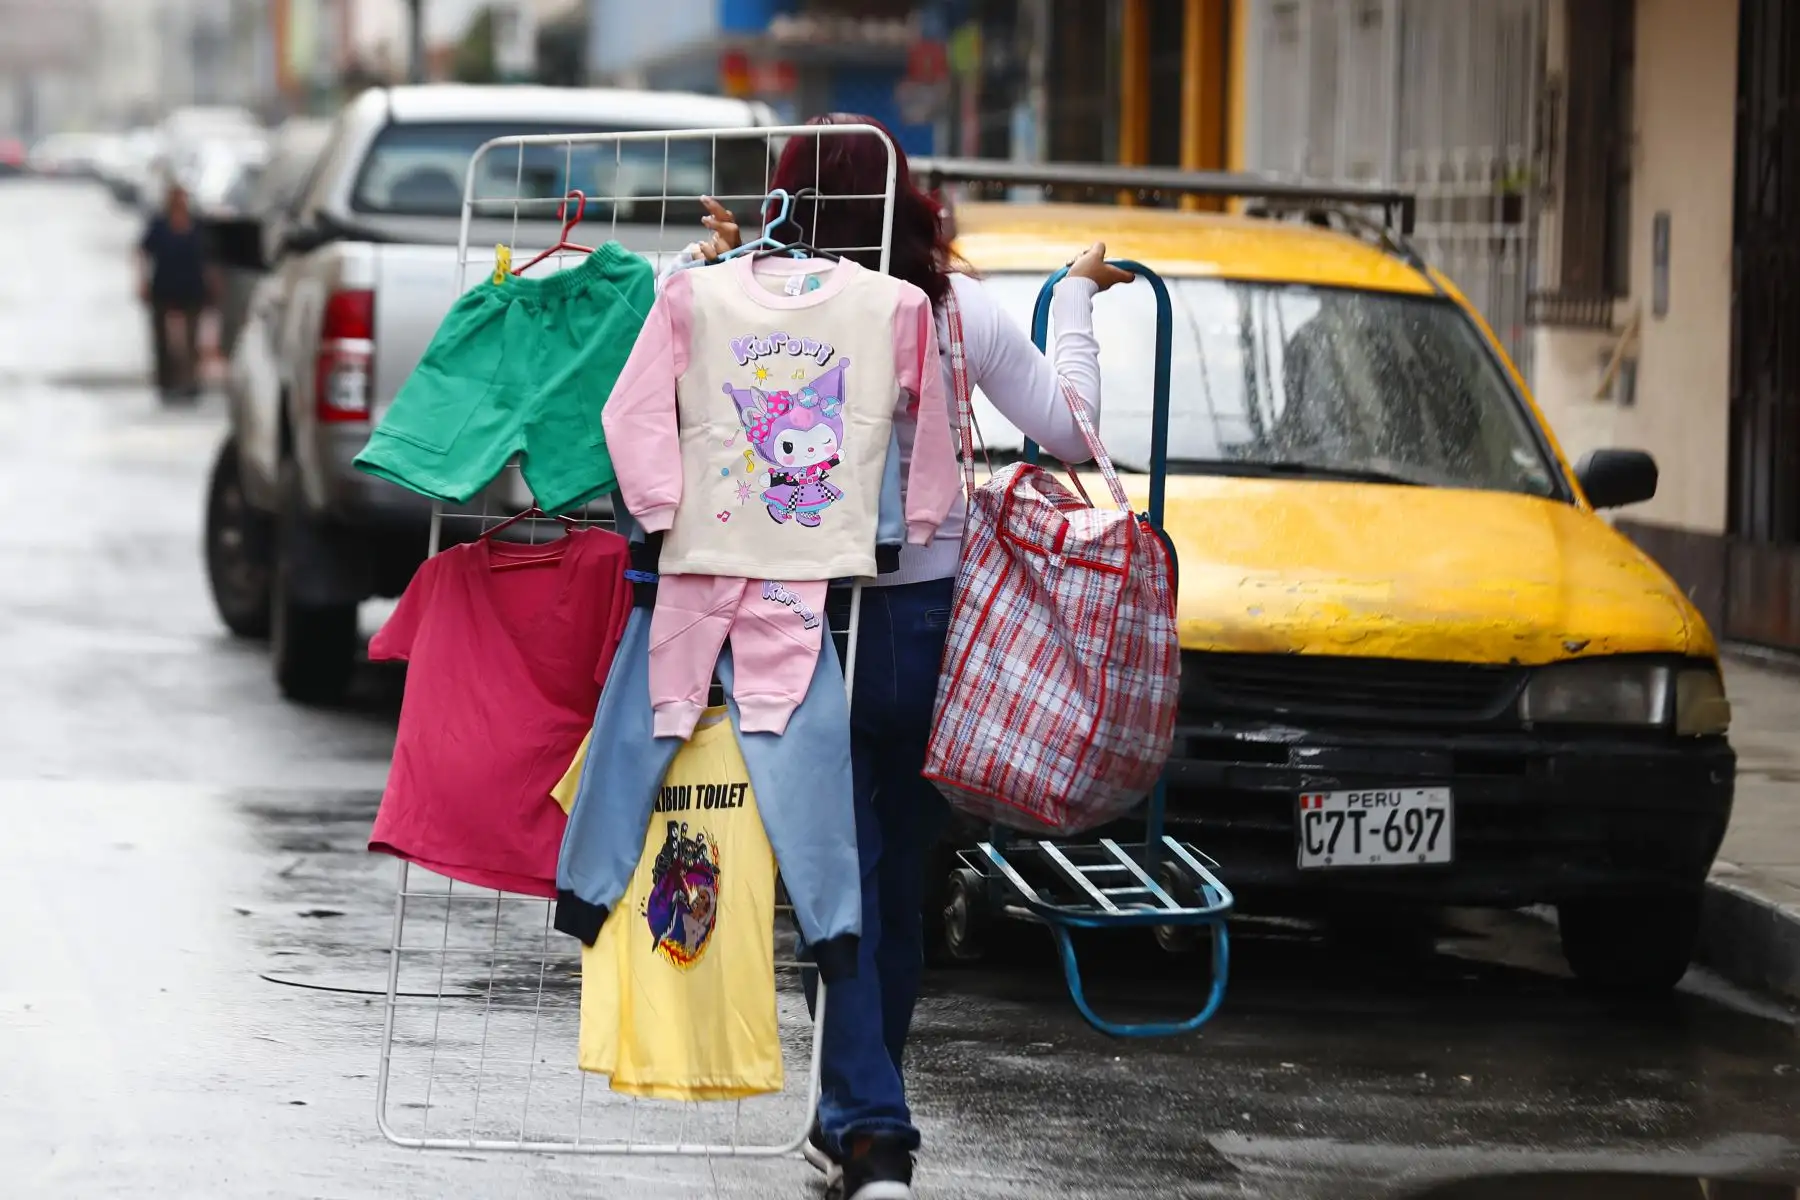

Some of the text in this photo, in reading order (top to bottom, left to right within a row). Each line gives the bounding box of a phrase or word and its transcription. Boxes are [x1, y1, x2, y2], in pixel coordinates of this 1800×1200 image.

[730, 331, 834, 366] Kuromi
[762, 581, 819, 630] Kuromi
[696, 783, 748, 810] TOILET
[1348, 792, 1401, 808] PERU
[1305, 808, 1445, 855] C7T-697
